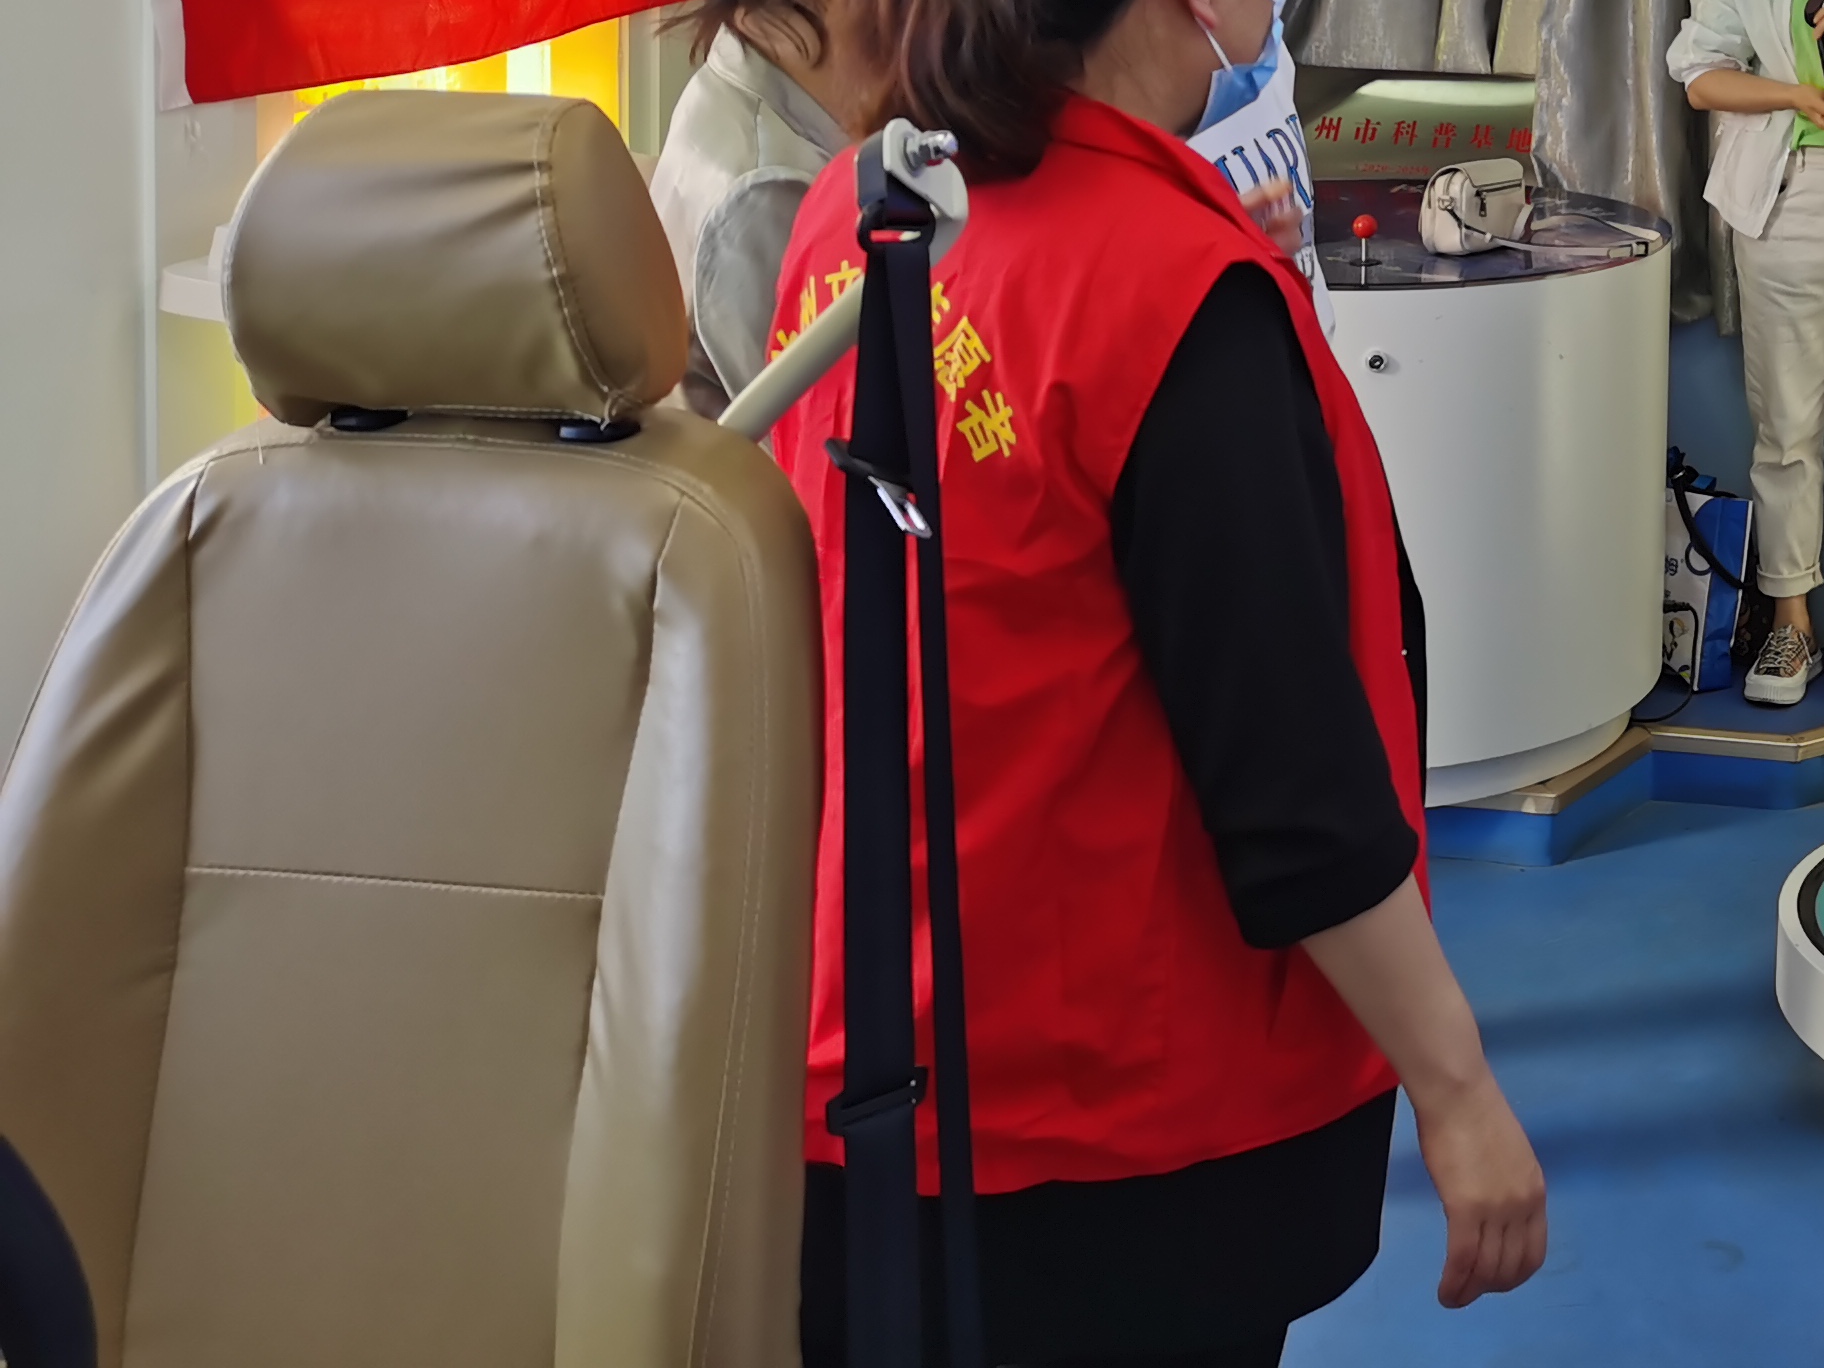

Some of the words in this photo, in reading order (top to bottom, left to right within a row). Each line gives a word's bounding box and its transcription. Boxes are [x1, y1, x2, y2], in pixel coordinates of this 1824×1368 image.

[1313, 115, 1534, 154] 州市科普基地
